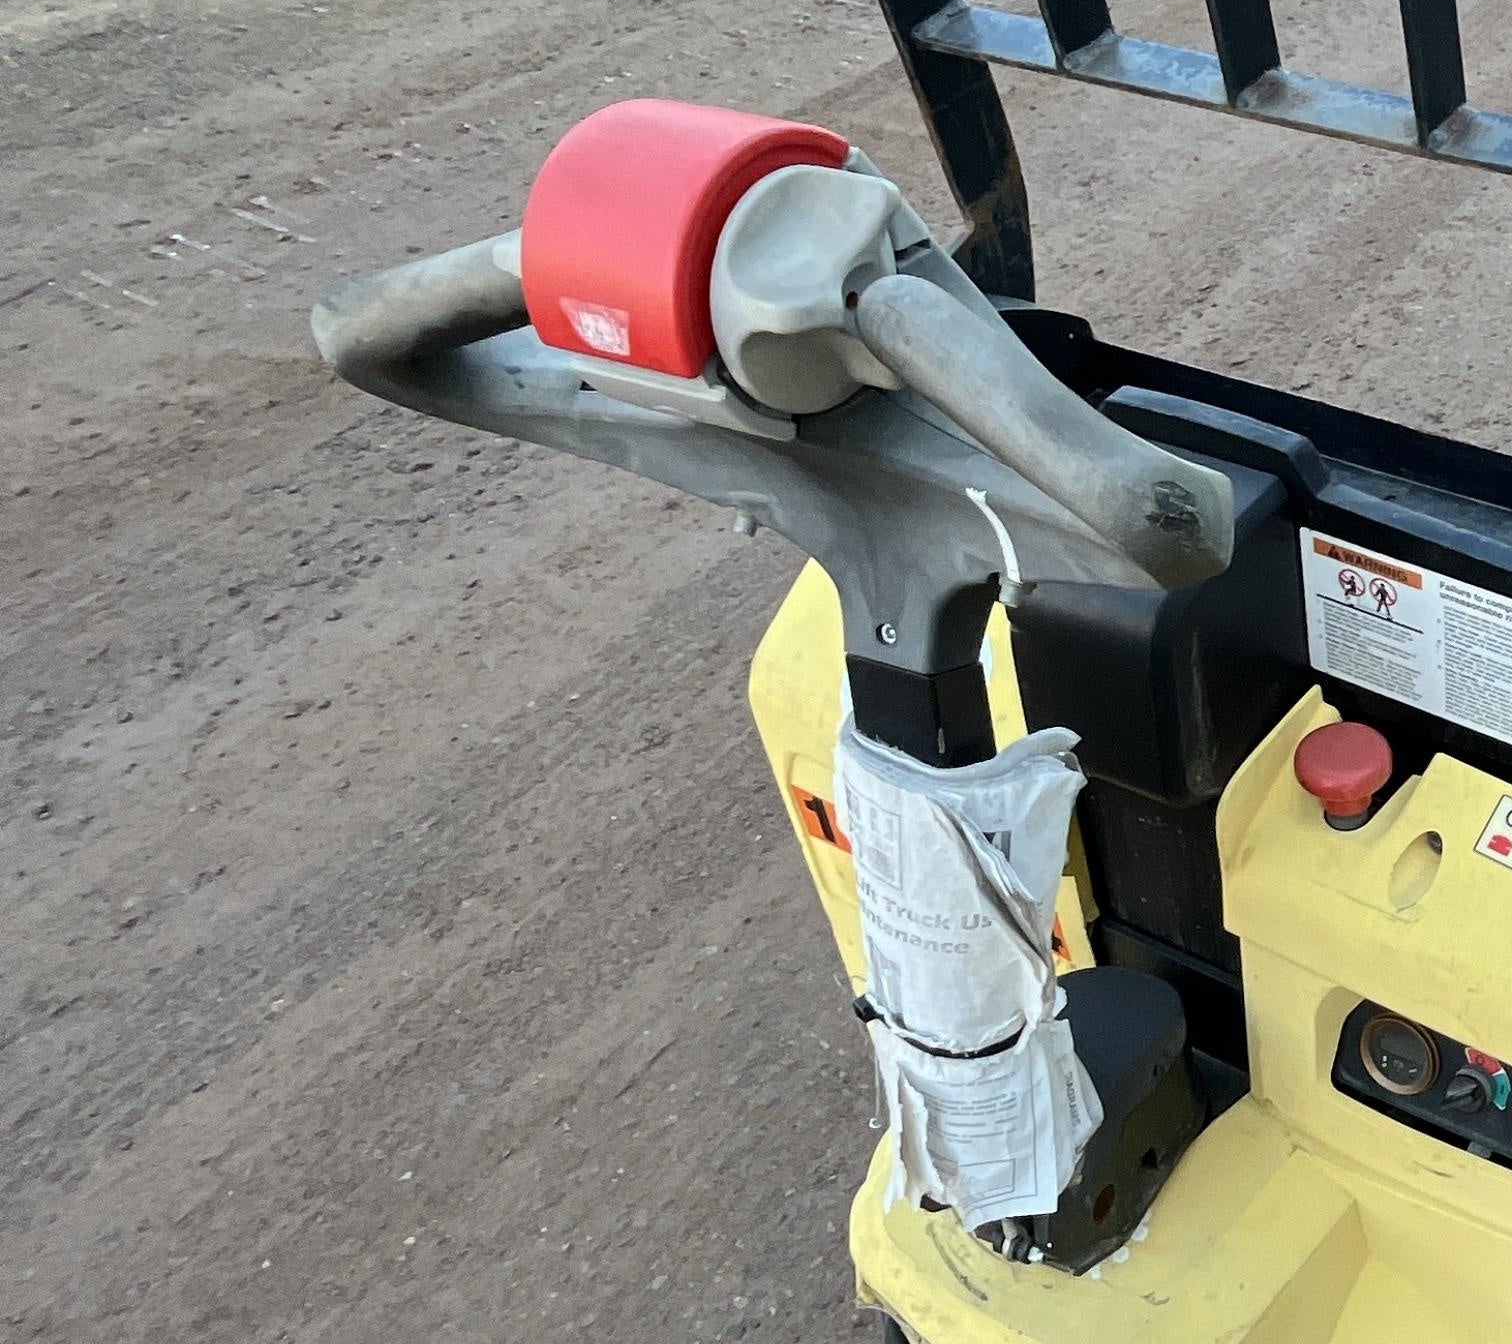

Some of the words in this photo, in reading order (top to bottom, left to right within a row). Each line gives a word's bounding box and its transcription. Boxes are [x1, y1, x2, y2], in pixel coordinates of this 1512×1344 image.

[1343, 550, 1409, 583] WARNING
[1439, 580, 1472, 599] Failure
[1473, 593, 1484, 603] to
[1439, 591, 1504, 619] unreasonable
[883, 896, 951, 931] Truck
